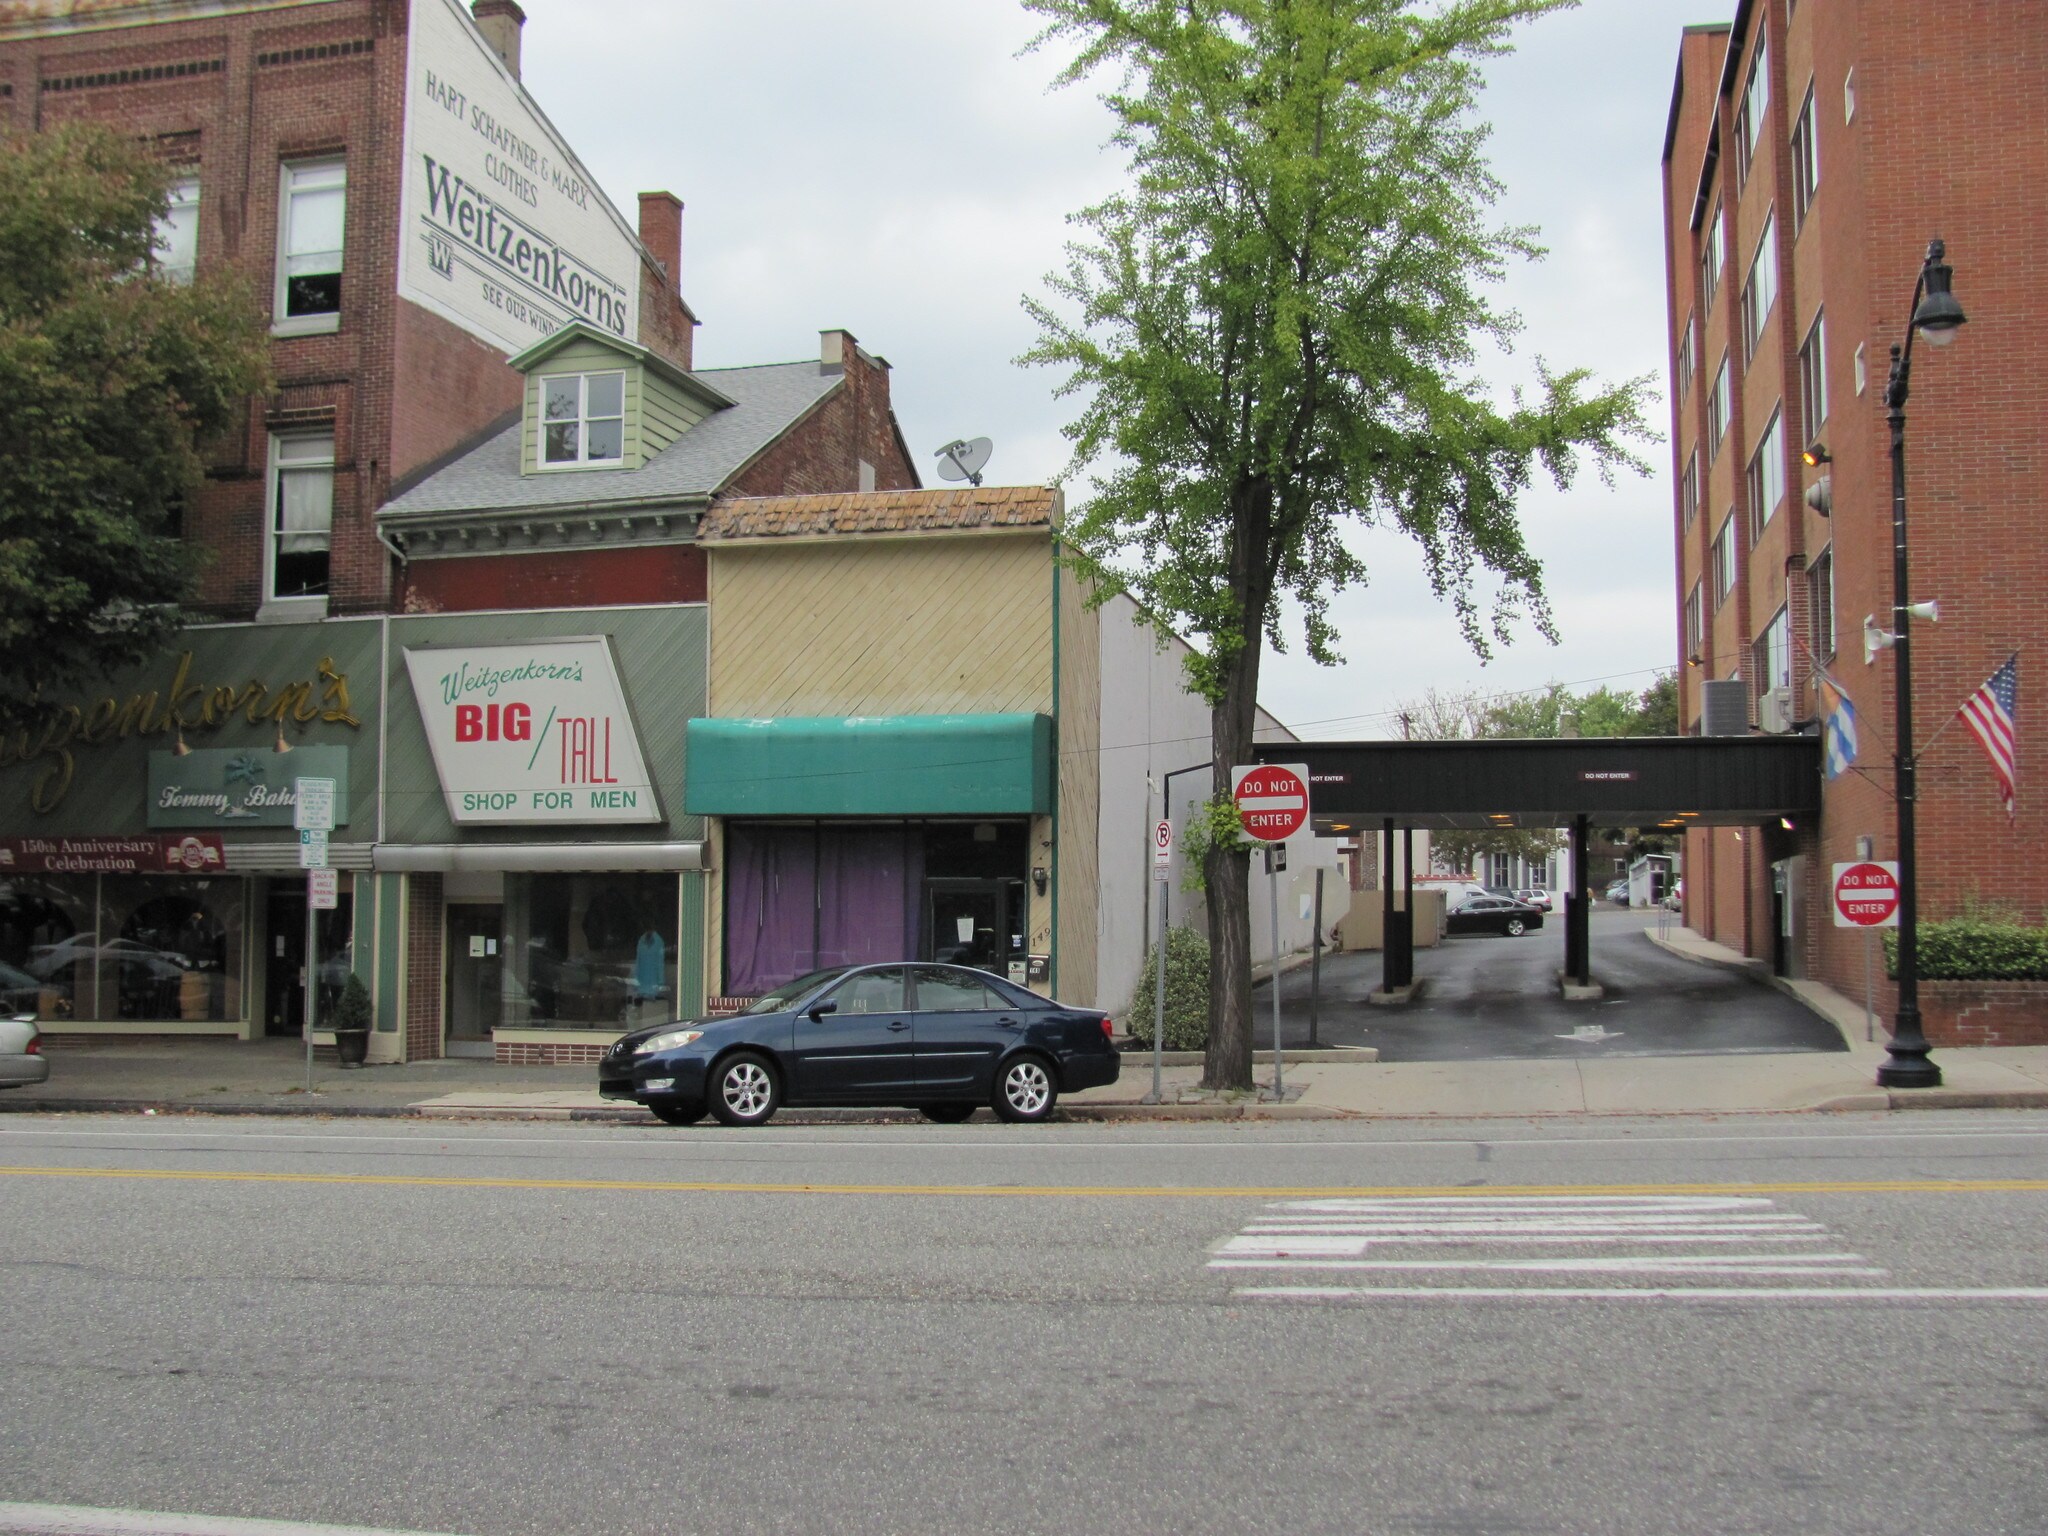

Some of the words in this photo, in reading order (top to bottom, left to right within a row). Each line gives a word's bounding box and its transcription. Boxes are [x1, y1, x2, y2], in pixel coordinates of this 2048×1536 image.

[426, 70, 467, 120] HART
[470, 105, 538, 174] SCHAFFNER
[540, 158, 549, 181] &
[552, 166, 590, 211] MARX
[485, 153, 538, 208] CLOTHES
[482, 282, 503, 310] SEE
[505, 297, 527, 323] OUR
[440, 658, 583, 705] Weitzenkorn's
[0, 650, 360, 814] zenkorn's
[455, 702, 531, 742] BIG
[557, 717, 618, 784] TALL
[1244, 781, 1262, 794] DO
[1270, 779, 1297, 793] NOT
[159, 785, 231, 815] Tommy
[463, 793, 518, 810] SHOP
[533, 792, 573, 809] FOR
[590, 791, 637, 808] MEN
[1250, 814, 1293, 828] ENTER
[21, 839, 58, 854] 150th
[61, 838, 156, 855] Anniversary
[303, 831, 309, 843] 3
[45, 855, 137, 870] Celebration
[1843, 876, 1860, 886] DO
[1866, 875, 1889, 885] NOT
[313, 889, 335, 897] PARKING
[1848, 903, 1886, 915] ENTER
[1032, 928, 1050, 947] 149
